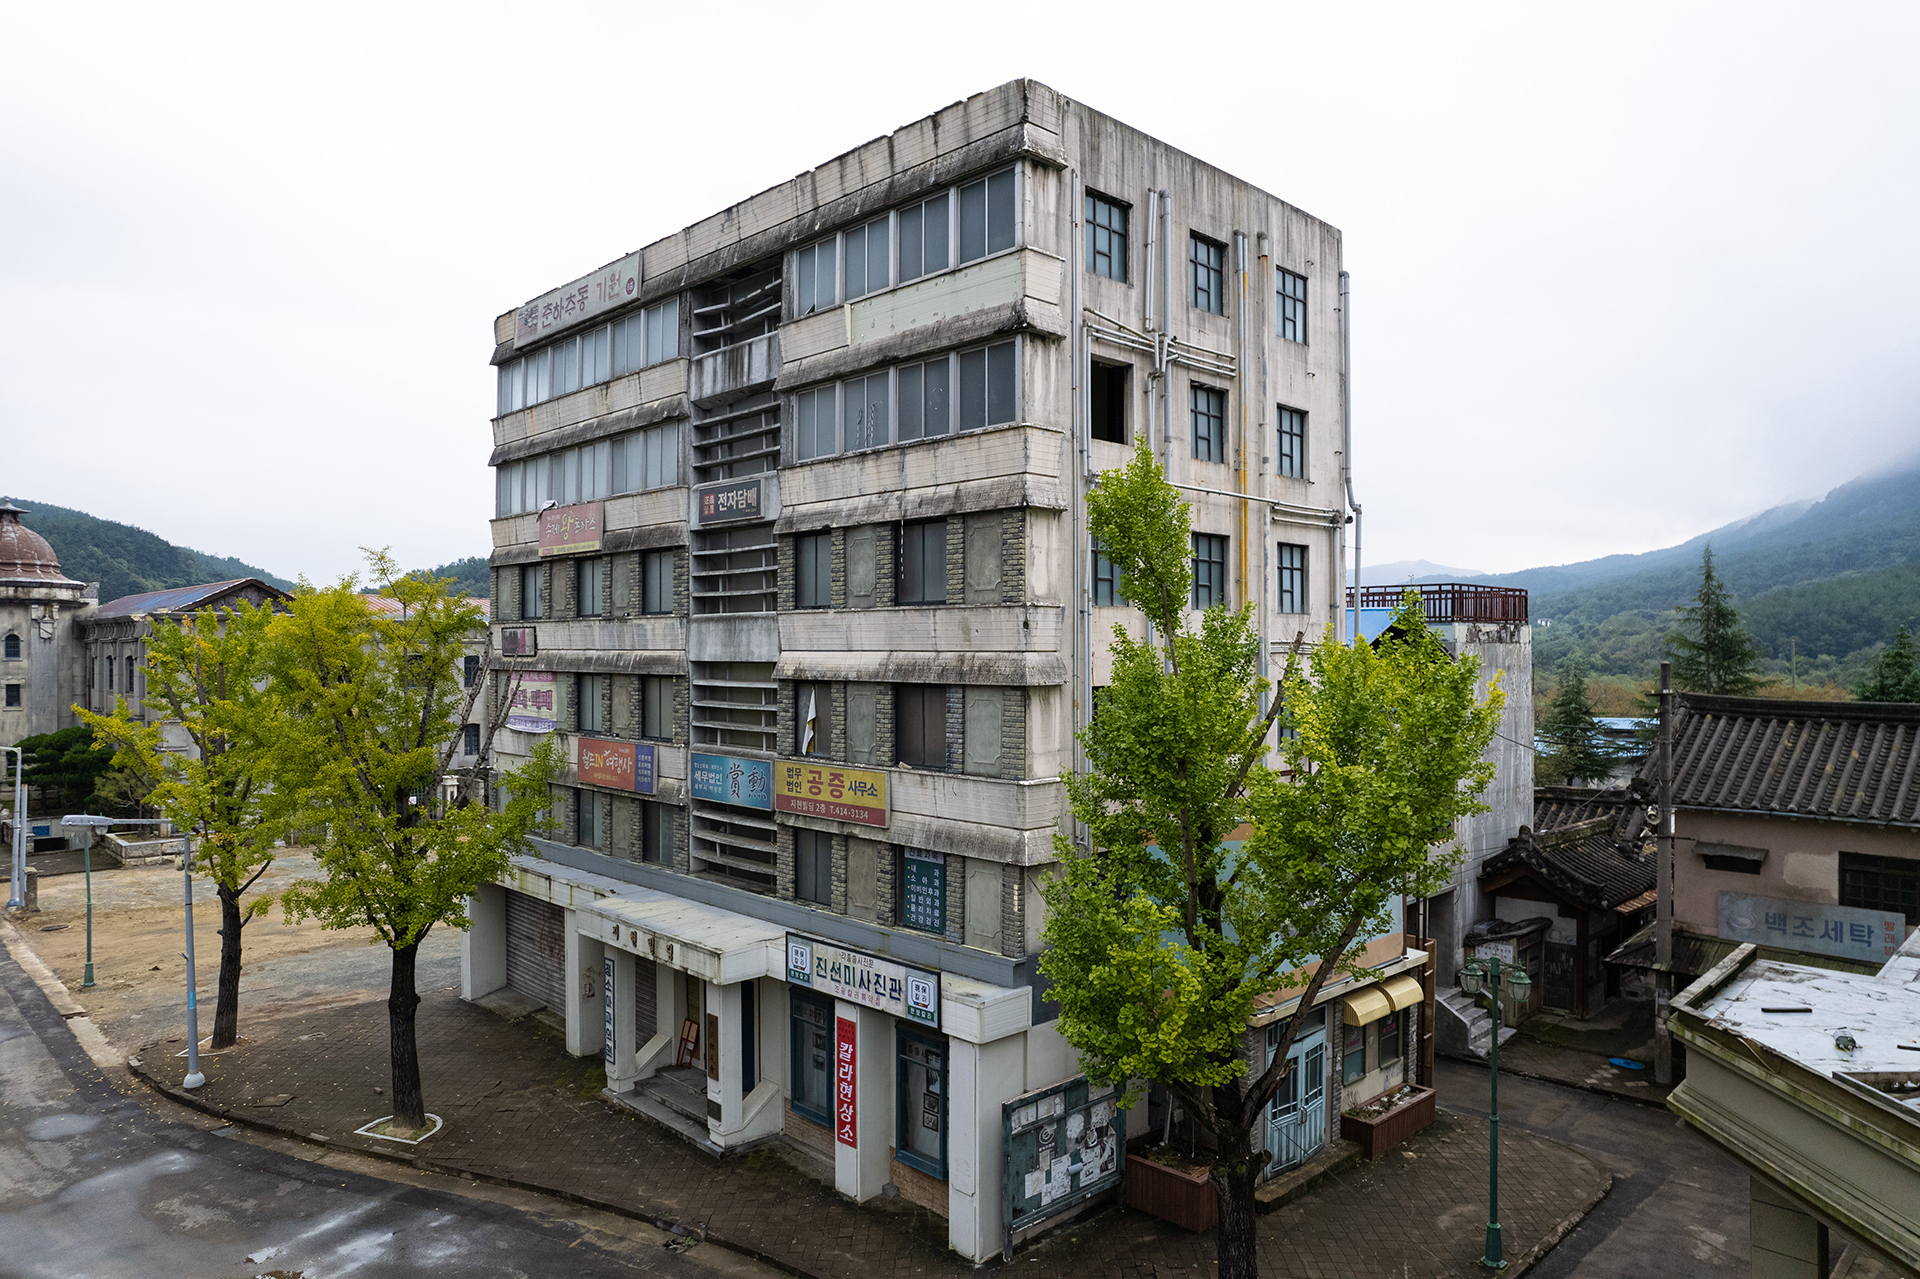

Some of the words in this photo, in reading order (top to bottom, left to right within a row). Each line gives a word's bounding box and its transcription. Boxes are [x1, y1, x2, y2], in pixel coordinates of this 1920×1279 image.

[596, 269, 622, 303] 기원
[717, 487, 757, 512] 전자담배
[693, 770, 723, 785] 세무법인
[786, 766, 802, 780] 법무
[807, 769, 846, 799] 공증
[848, 780, 878, 797] 사무소
[786, 780, 802, 794] 법인
[790, 799, 814, 811] 지현빌딩
[816, 803, 826, 814] 2층
[829, 805, 869, 819] T.414-3134
[1764, 911, 1875, 948] 백조세탁
[1883, 920, 1896, 957] 빨래방
[839, 1041, 854, 1142] 칼라현상소
